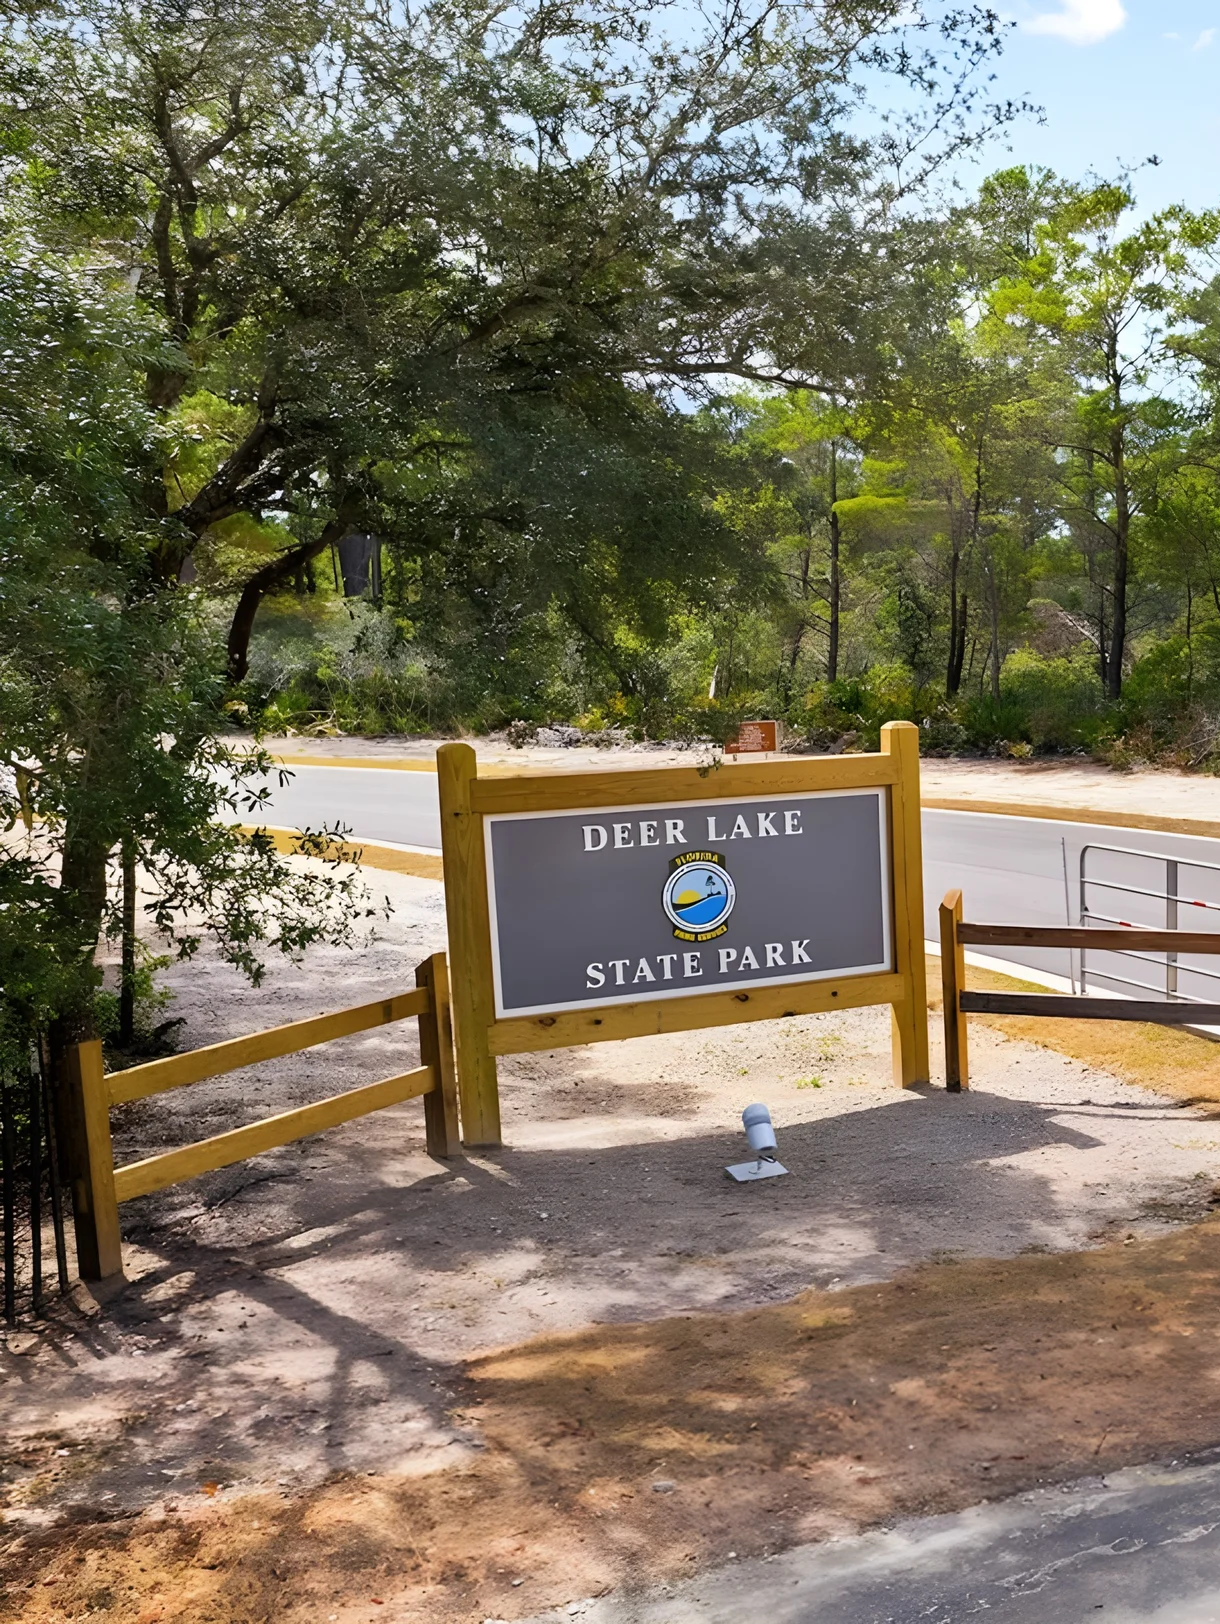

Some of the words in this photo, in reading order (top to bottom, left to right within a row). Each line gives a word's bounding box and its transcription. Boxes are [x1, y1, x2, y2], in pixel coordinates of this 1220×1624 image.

[582, 819, 688, 852] DEER
[706, 810, 803, 841] LAKE
[586, 952, 703, 989] STATE
[718, 939, 813, 973] PARK
